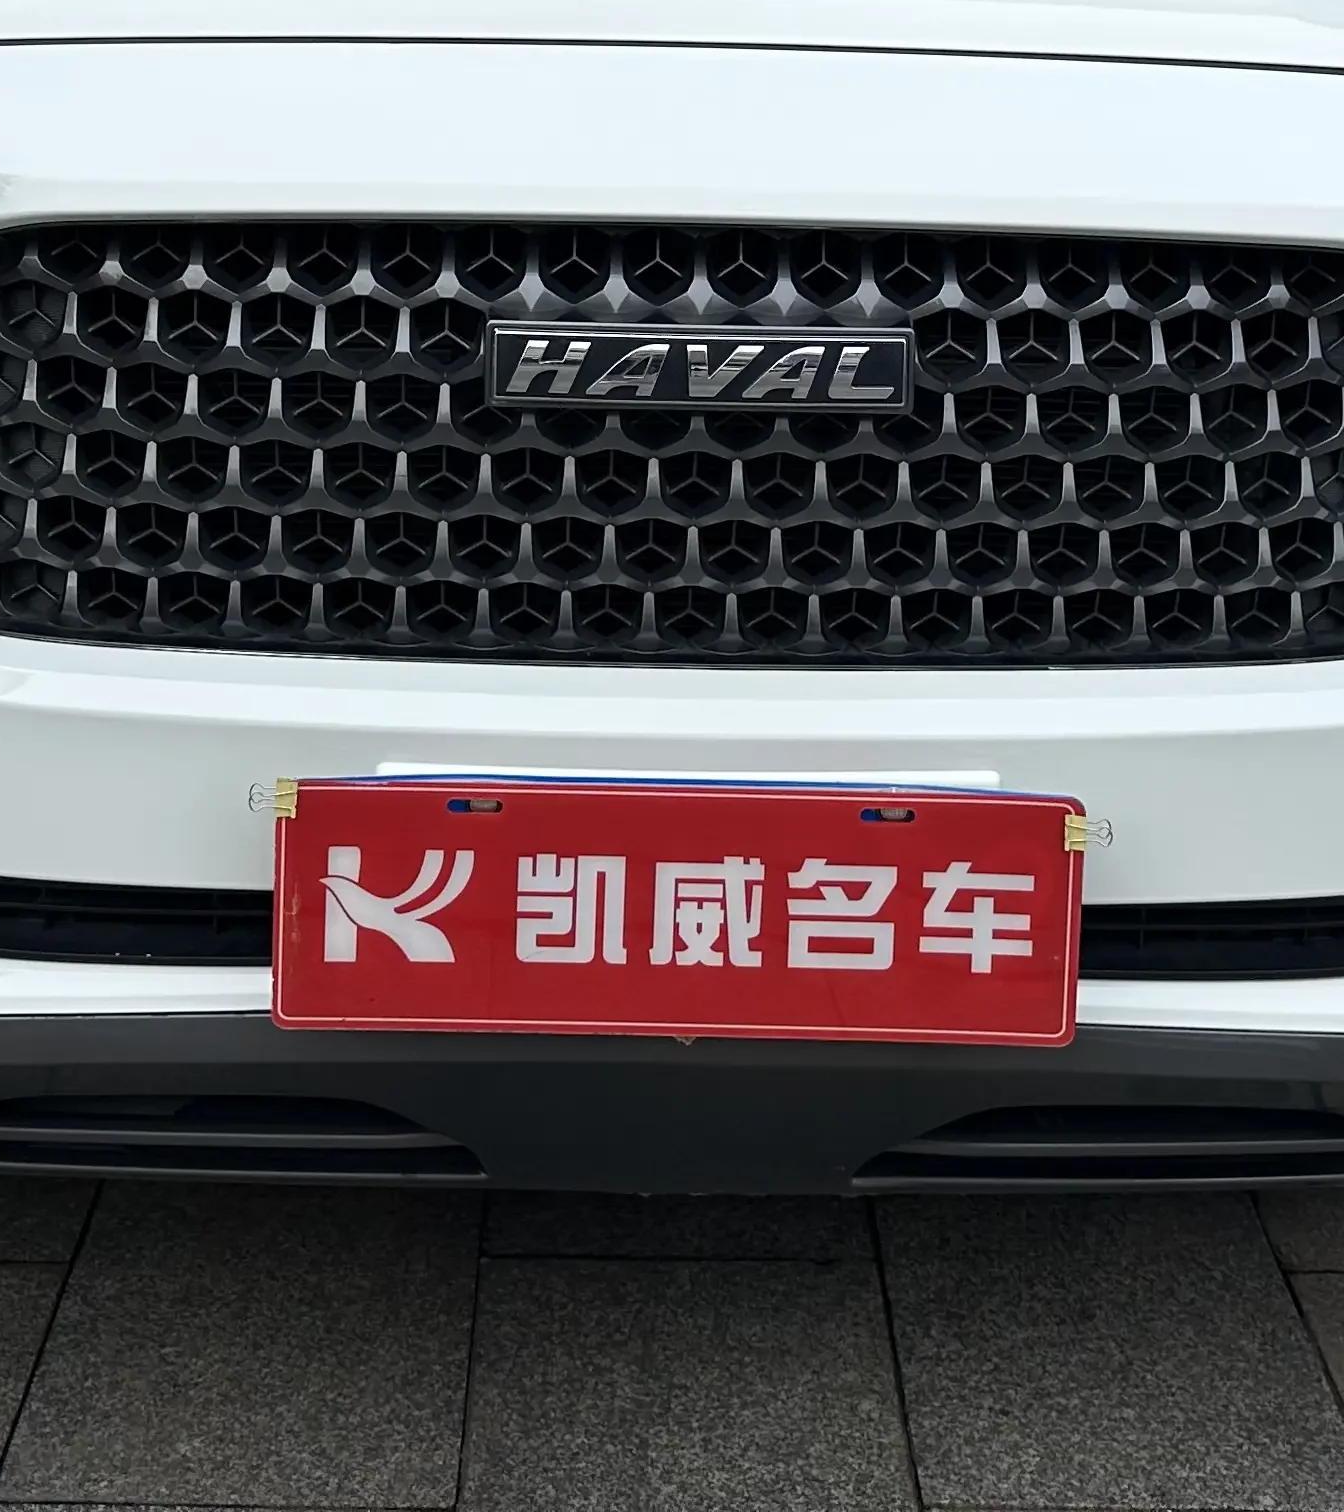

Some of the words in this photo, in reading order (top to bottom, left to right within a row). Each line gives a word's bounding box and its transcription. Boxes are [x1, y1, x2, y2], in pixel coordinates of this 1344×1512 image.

[505, 340, 896, 399] HAVAL
[516, 854, 1036, 974] 凯威名车
